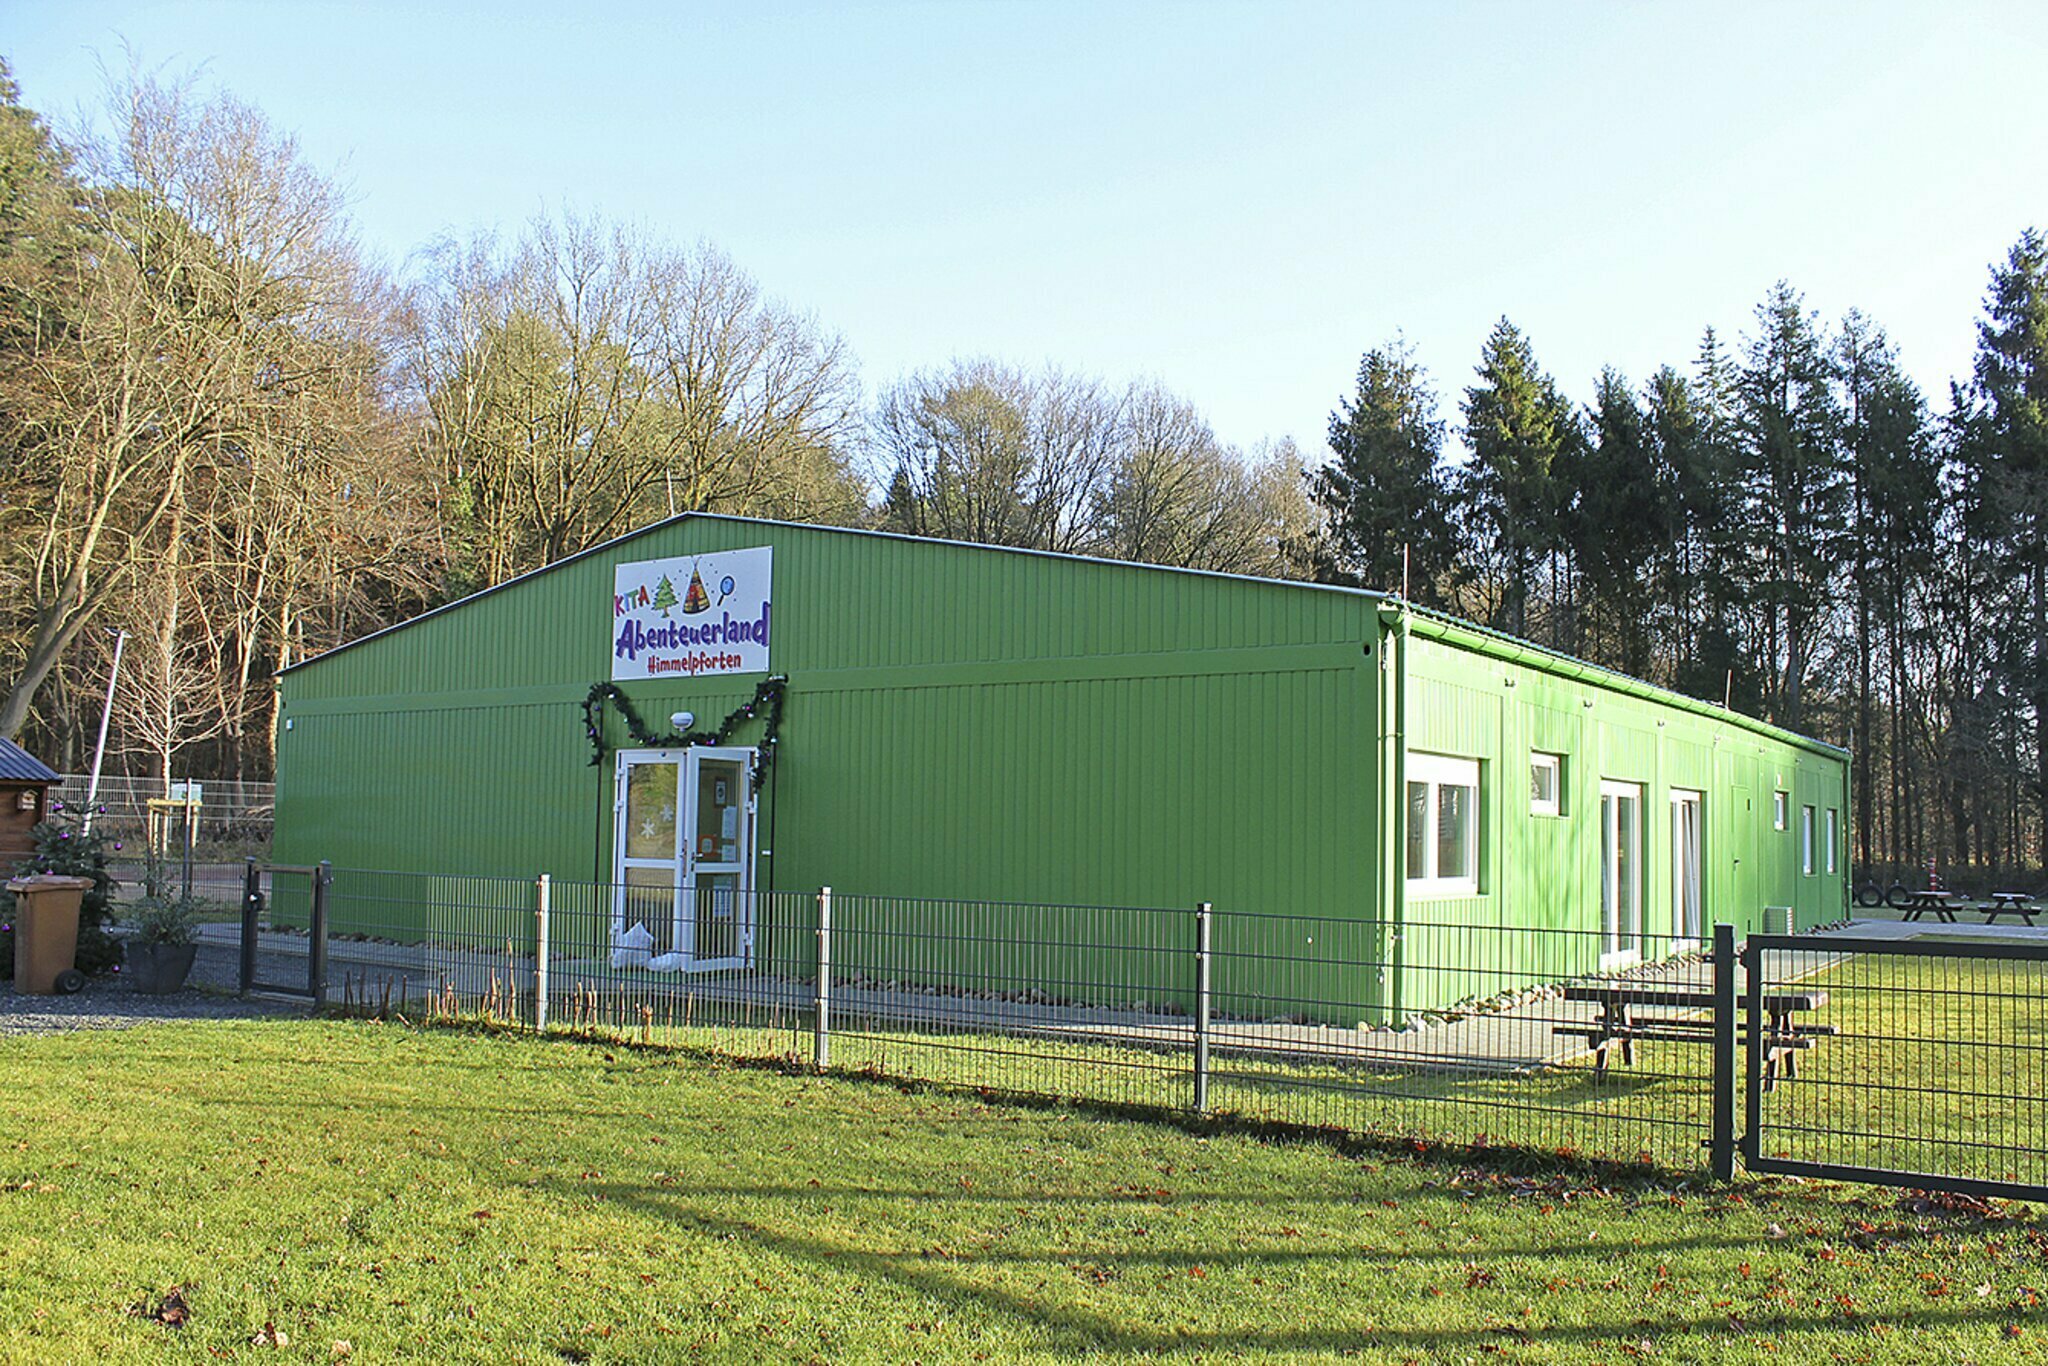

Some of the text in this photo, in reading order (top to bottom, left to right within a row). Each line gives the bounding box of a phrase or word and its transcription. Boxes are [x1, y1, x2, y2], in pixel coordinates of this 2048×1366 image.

[614, 585, 650, 617] KITA
[616, 602, 771, 660] Abenteuerland
[648, 651, 741, 675] Himmelpforten
